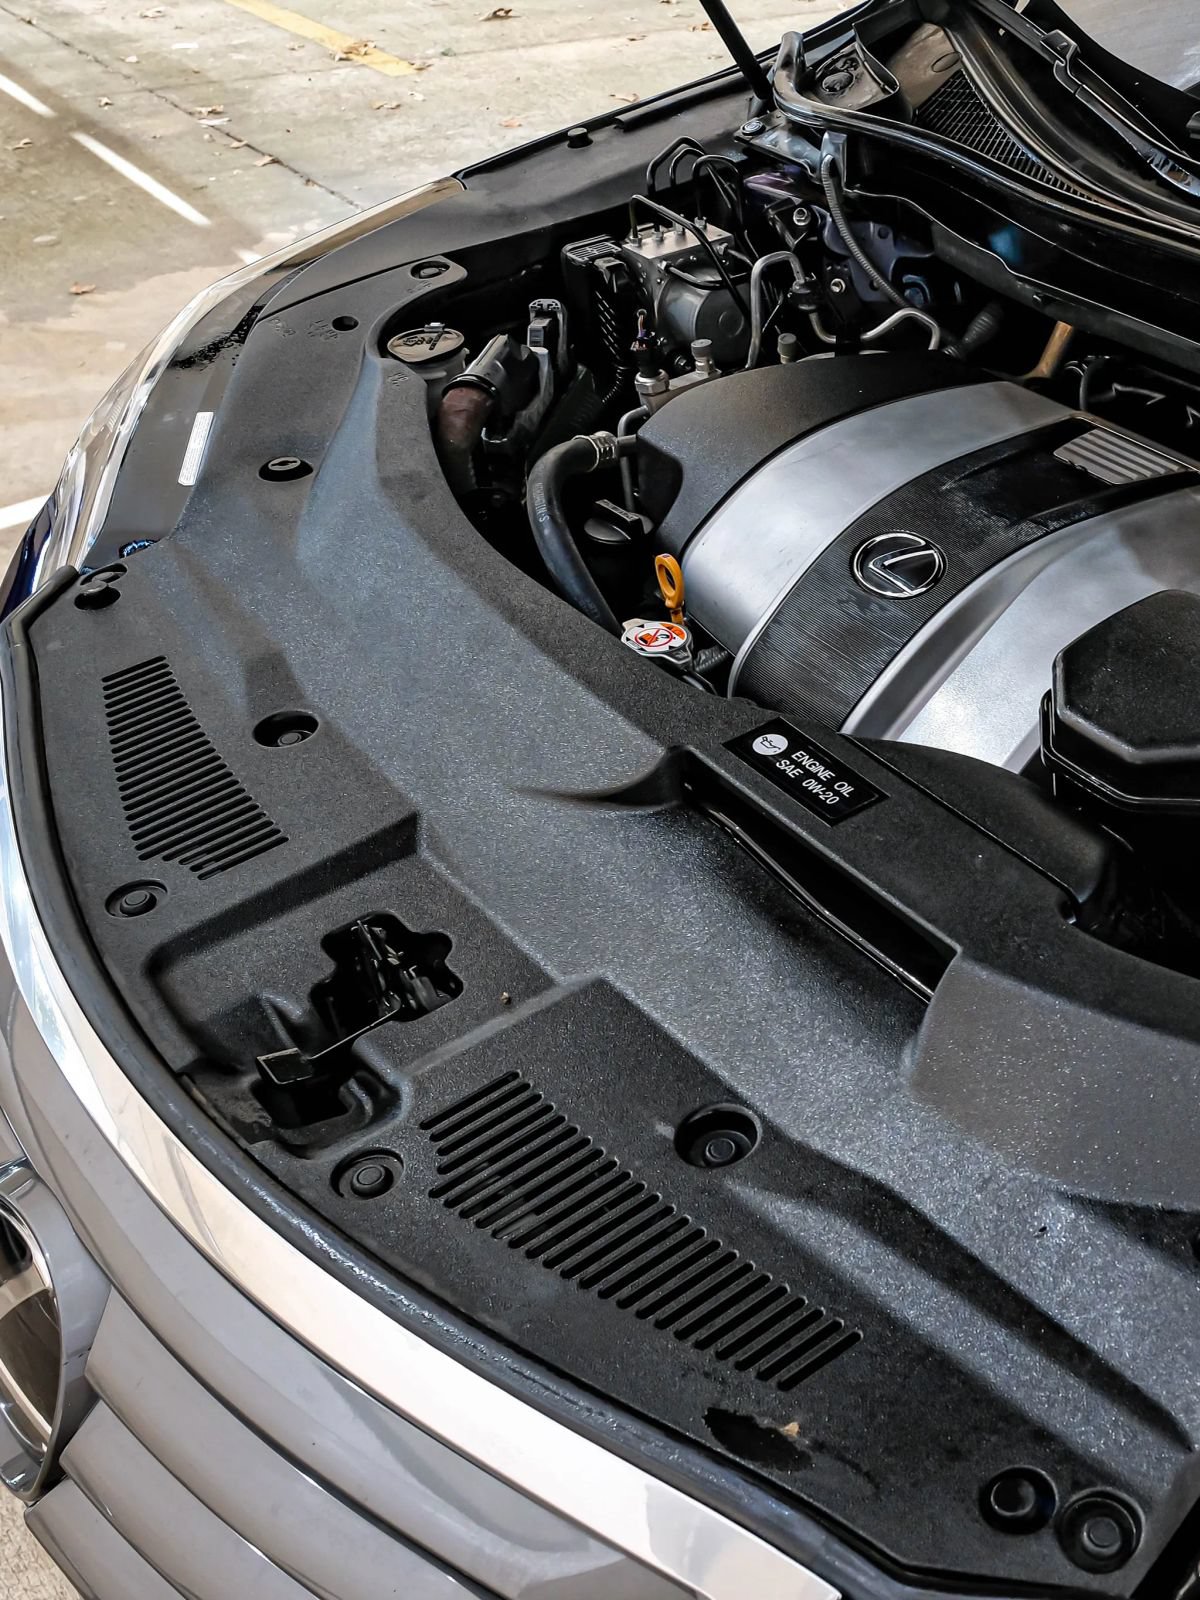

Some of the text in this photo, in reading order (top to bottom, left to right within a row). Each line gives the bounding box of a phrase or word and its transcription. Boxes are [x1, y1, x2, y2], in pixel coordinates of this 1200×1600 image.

[775, 759, 839, 805] SAE 0W-20
[791, 750, 856, 798] ENGINE OIL
